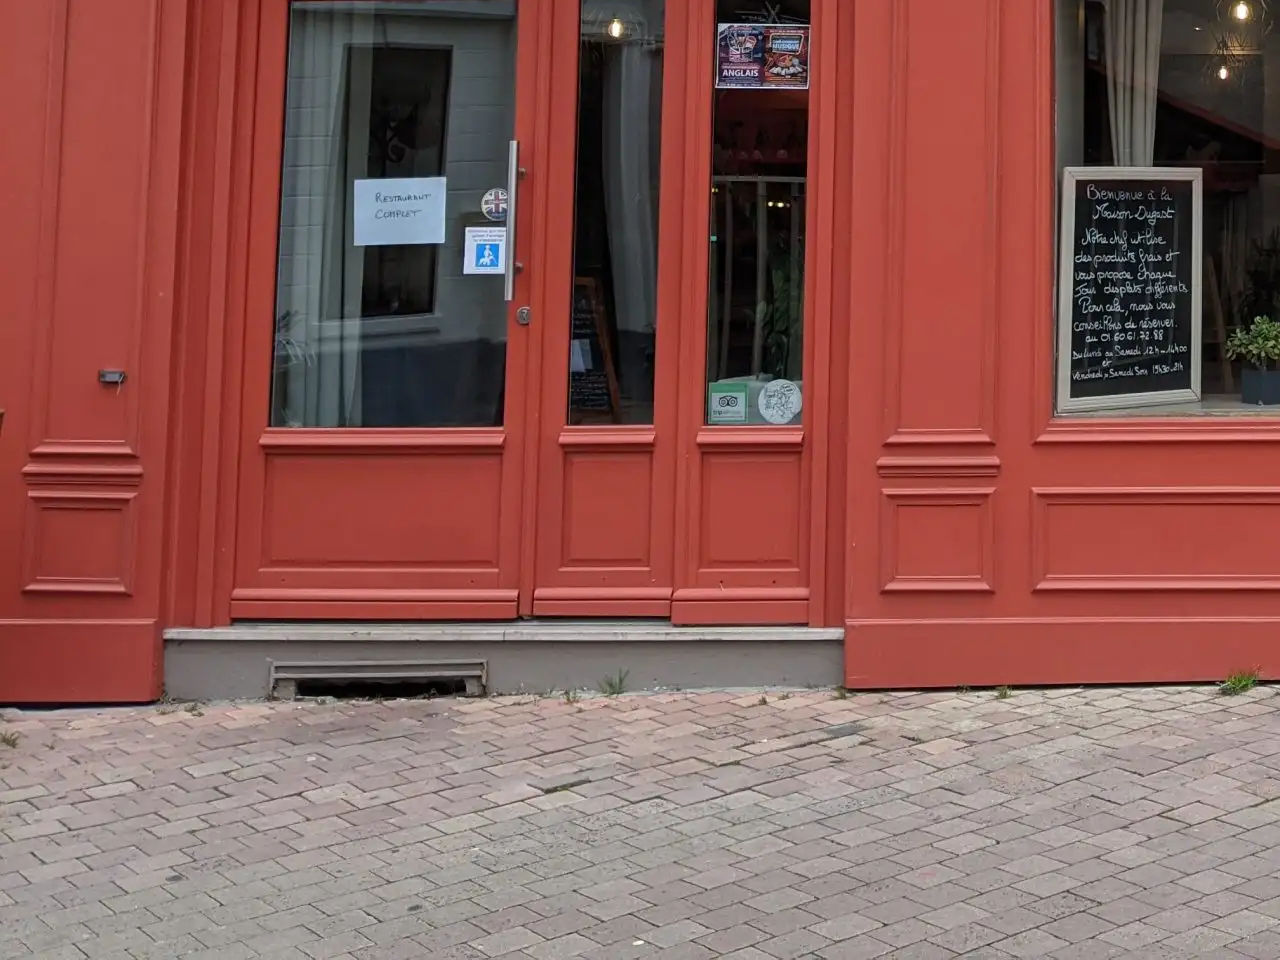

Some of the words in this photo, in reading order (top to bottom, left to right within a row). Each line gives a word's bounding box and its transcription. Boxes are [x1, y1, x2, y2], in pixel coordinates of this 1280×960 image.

[722, 69, 759, 78] ANGLAIS
[1086, 183, 1144, 200] Bienvenue
[1160, 186, 1172, 200] la
[1092, 202, 1133, 219] Maison
[1134, 205, 1175, 225] Dugast
[1081, 227, 1108, 245] Notre
[1130, 229, 1166, 245] utilise
[1075, 250, 1092, 262] des
[1093, 249, 1136, 268] produits
[1138, 249, 1162, 271] frais
[1165, 249, 1180, 261] et
[1075, 272, 1095, 280] vous
[1097, 272, 1133, 284] propose
[1078, 296, 1104, 314] Pour
[1129, 302, 1153, 311] nous
[1156, 301, 1176, 310] vous
[1124, 316, 1137, 329] de
